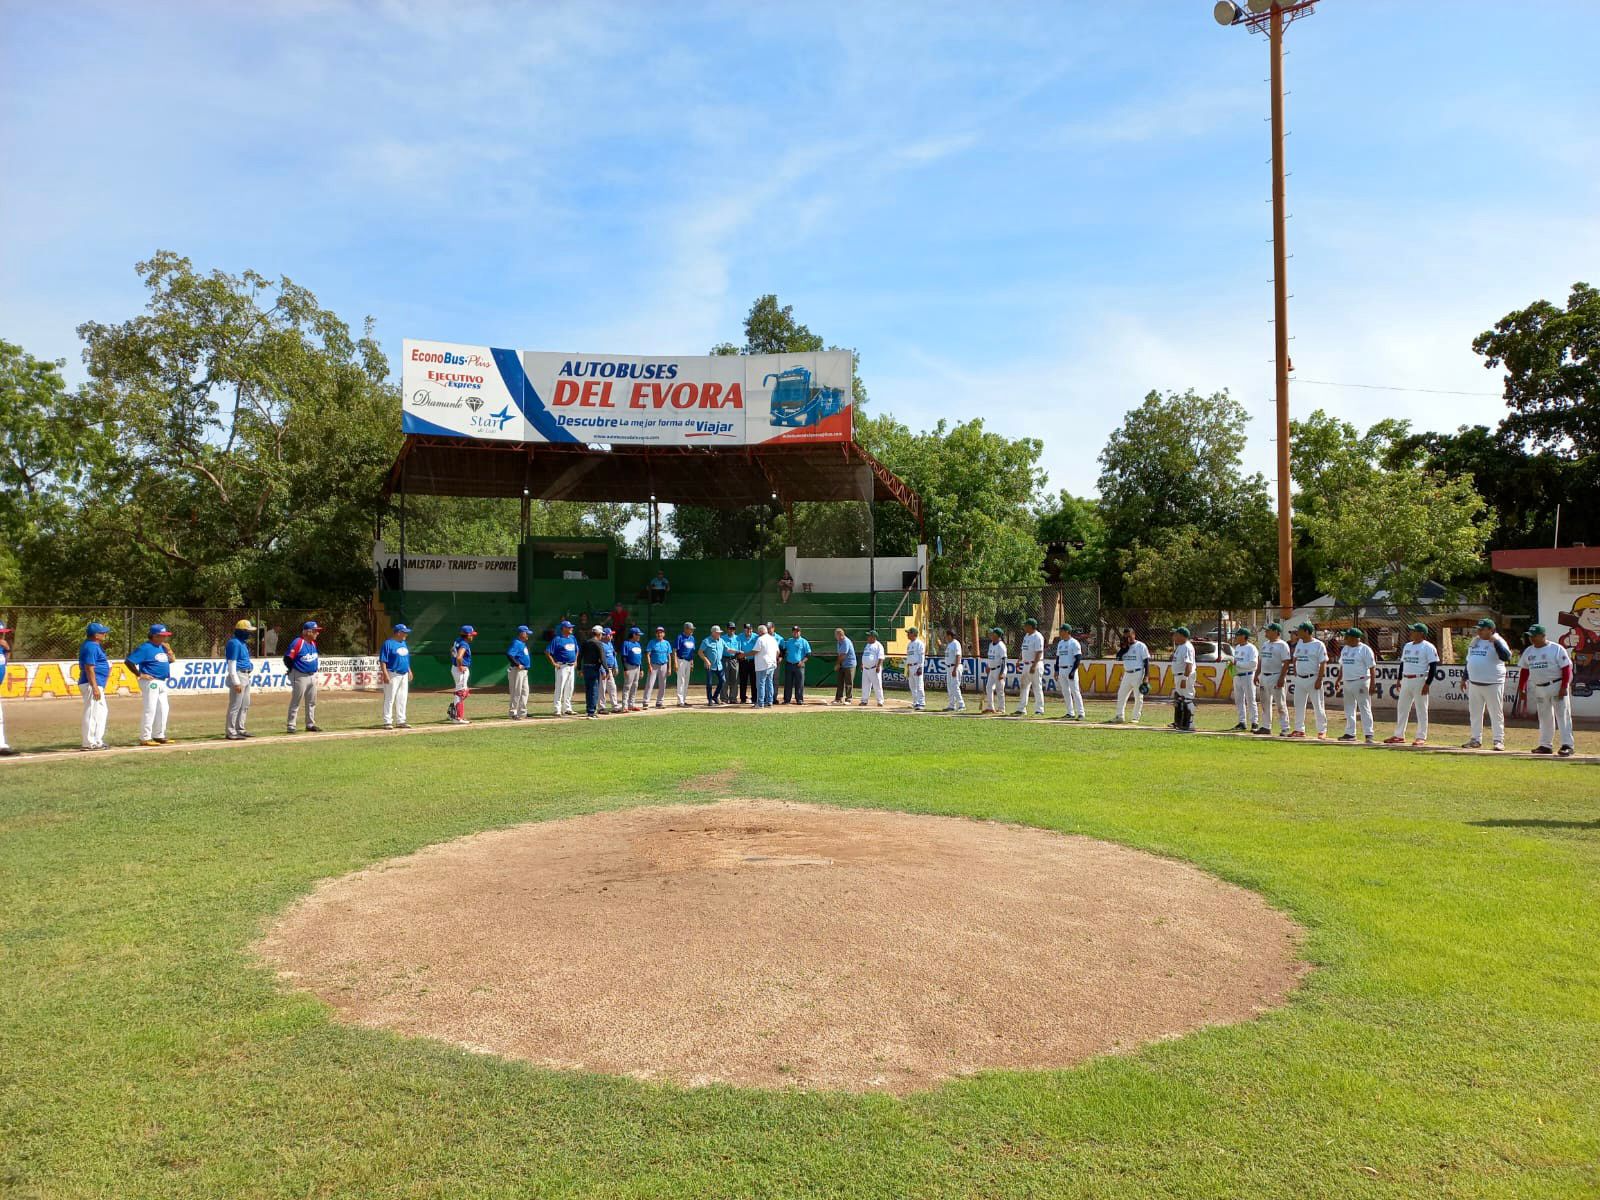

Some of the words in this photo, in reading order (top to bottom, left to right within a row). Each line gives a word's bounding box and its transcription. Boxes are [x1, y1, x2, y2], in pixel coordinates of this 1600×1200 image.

[559, 360, 678, 379] AUTOBUSES
[448, 380, 481, 389] Express
[412, 389, 463, 409] Diamante
[552, 380, 616, 408] DEL
[629, 382, 743, 409] EVORA
[557, 415, 618, 427] Descubre
[630, 419, 656, 428] mejor
[658, 418, 683, 427] forma
[685, 418, 696, 427] de
[696, 421, 734, 434] Viajar
[448, 560, 477, 570] TRAVES
[485, 560, 517, 571] DEPORTE
[260, 661, 271, 674] A
